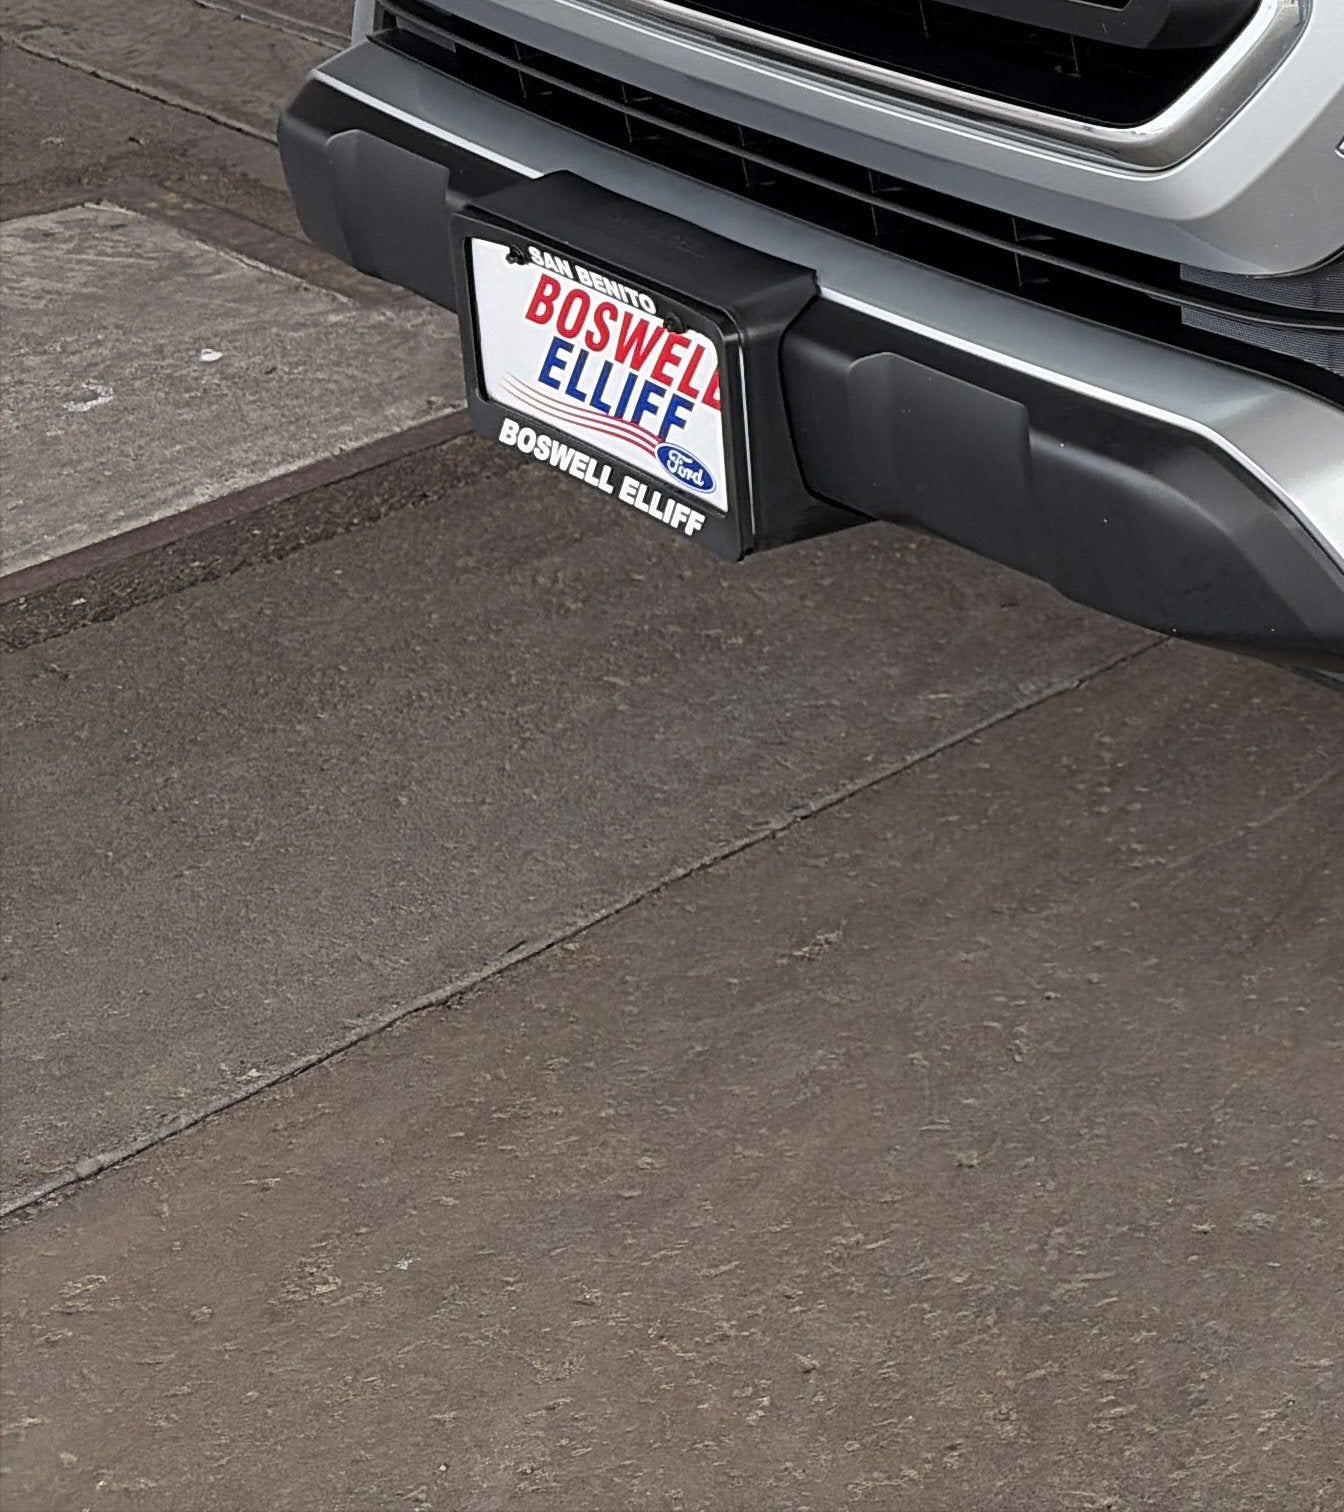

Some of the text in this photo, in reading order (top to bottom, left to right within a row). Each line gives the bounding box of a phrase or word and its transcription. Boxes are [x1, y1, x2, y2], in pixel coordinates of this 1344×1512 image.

[528, 246, 657, 316] SAN BENITO
[537, 335, 695, 442] ELLIFF
[499, 417, 706, 536] BOSWELL ELLIFF
[665, 450, 705, 487] Ford
